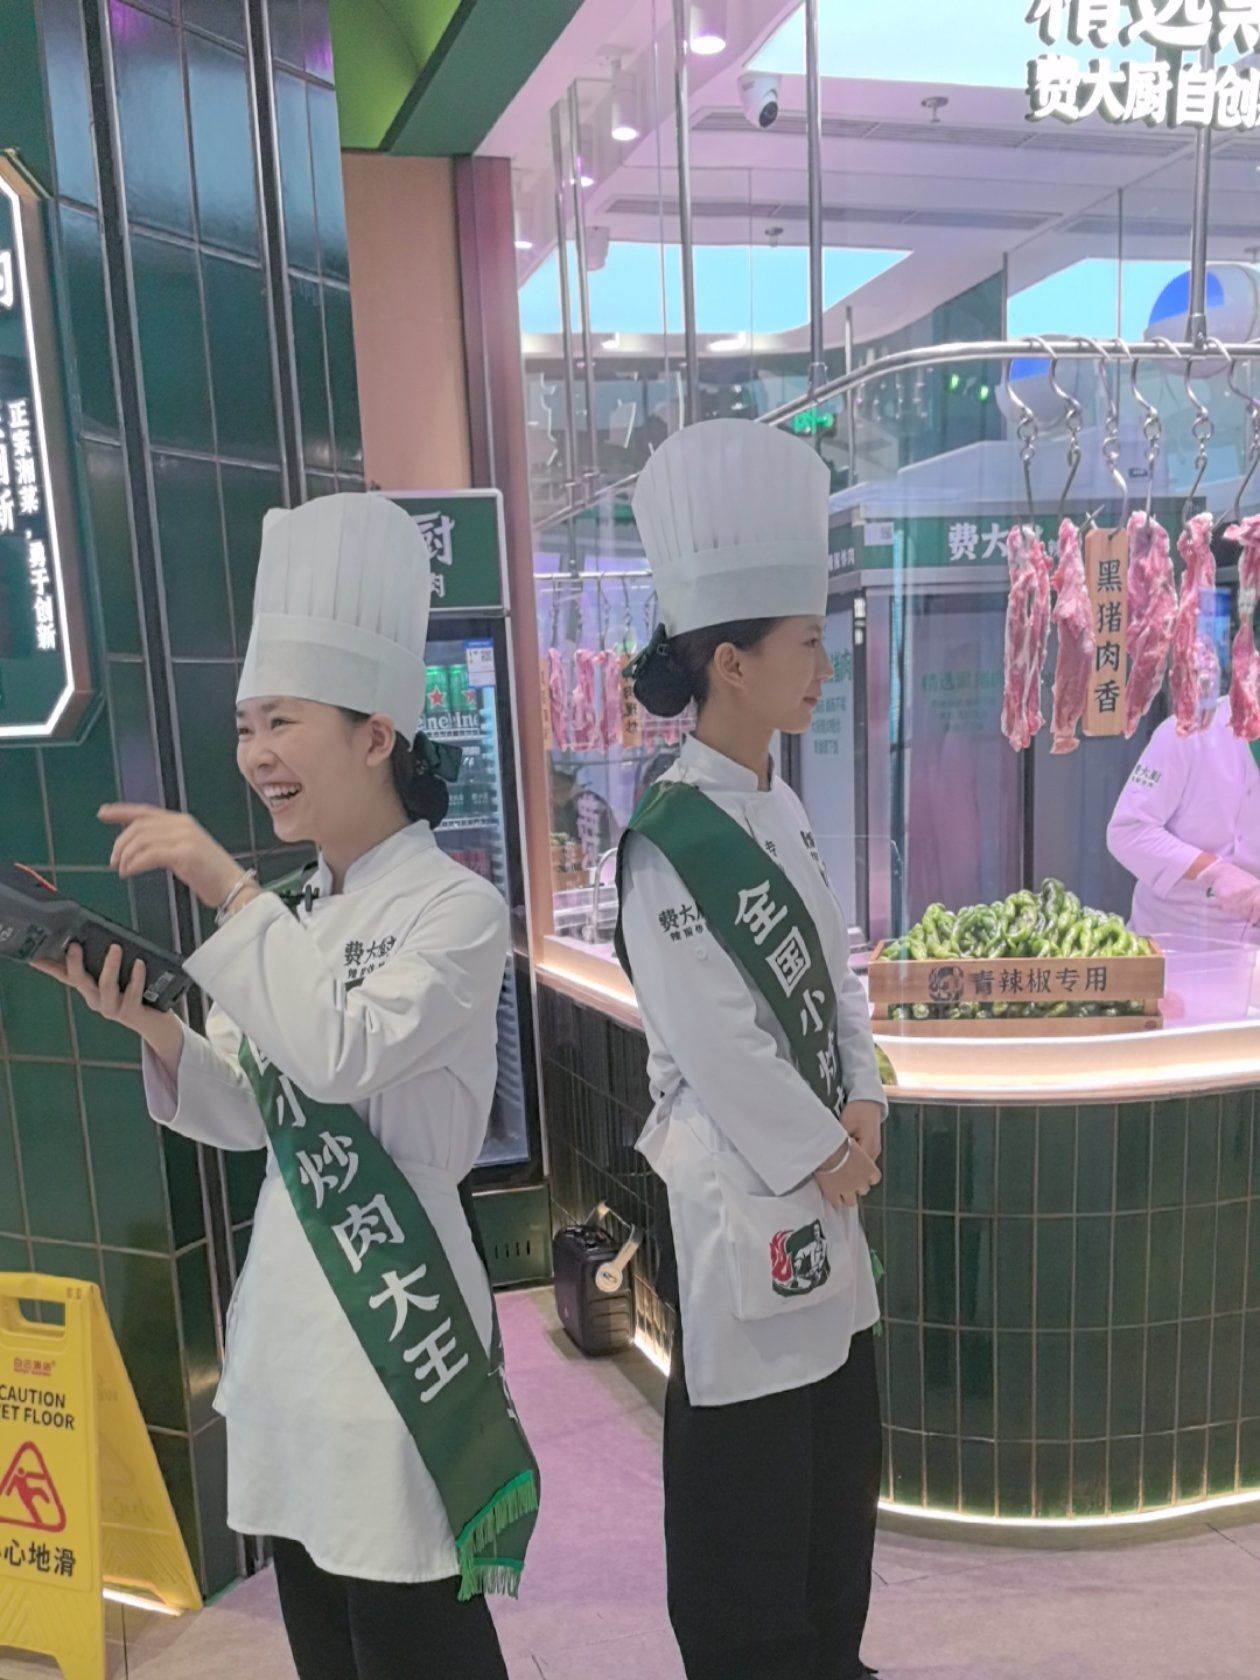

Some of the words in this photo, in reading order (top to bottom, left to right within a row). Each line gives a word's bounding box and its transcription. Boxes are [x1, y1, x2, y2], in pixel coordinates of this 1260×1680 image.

[949, 521, 1044, 561] 费大
[1094, 559, 1122, 713] 黑猪肉香
[658, 904, 701, 933] 费大
[970, 966, 1107, 997] 青辣椒专用
[252, 1048, 468, 1403] 小炒肉大王
[0, 1384, 66, 1409] CAUTION
[0, 1403, 20, 1421] ET
[24, 1407, 76, 1431] FLOOR
[0, 1539, 76, 1577] 心地滑
